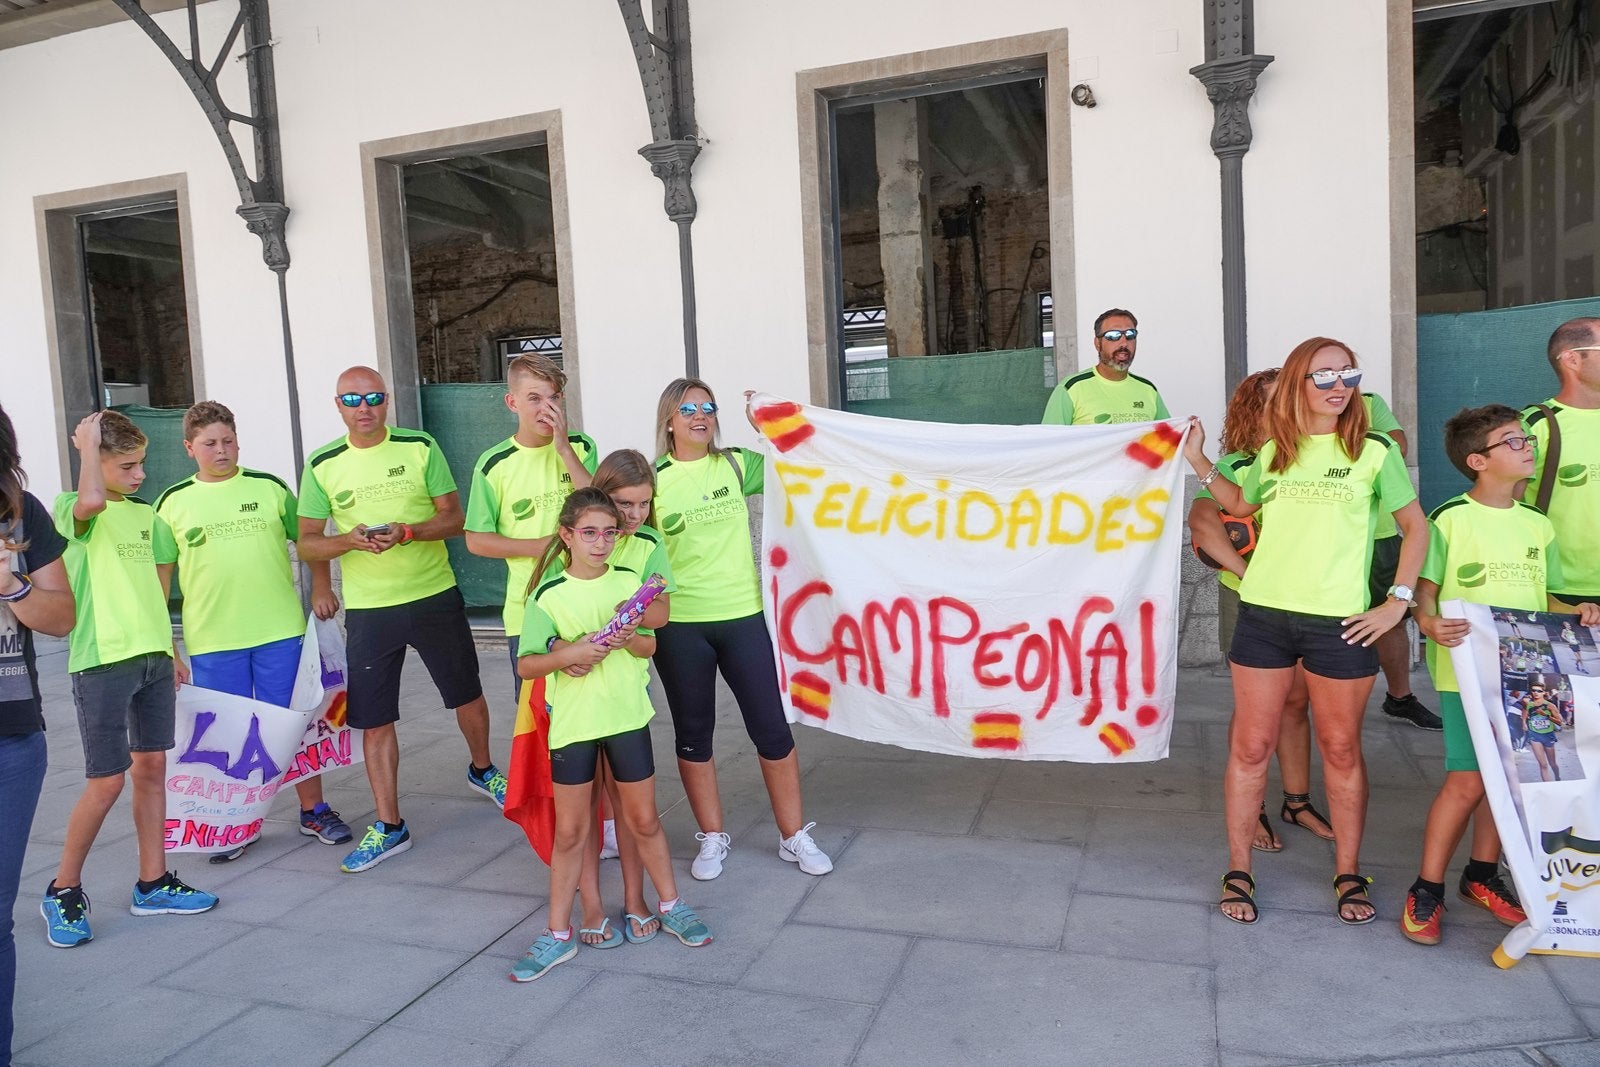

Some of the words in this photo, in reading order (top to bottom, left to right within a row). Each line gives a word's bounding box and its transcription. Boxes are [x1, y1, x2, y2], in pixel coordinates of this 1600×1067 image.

[1279, 487, 1354, 501] ROMACHO
[1318, 481, 1354, 493] DENTAL
[686, 503, 745, 523] ROMACHO
[238, 517, 266, 526] DENTAL
[206, 522, 267, 537] ROMACHO
[176, 711, 282, 784] LA
[166, 774, 282, 806] CAMPEO
